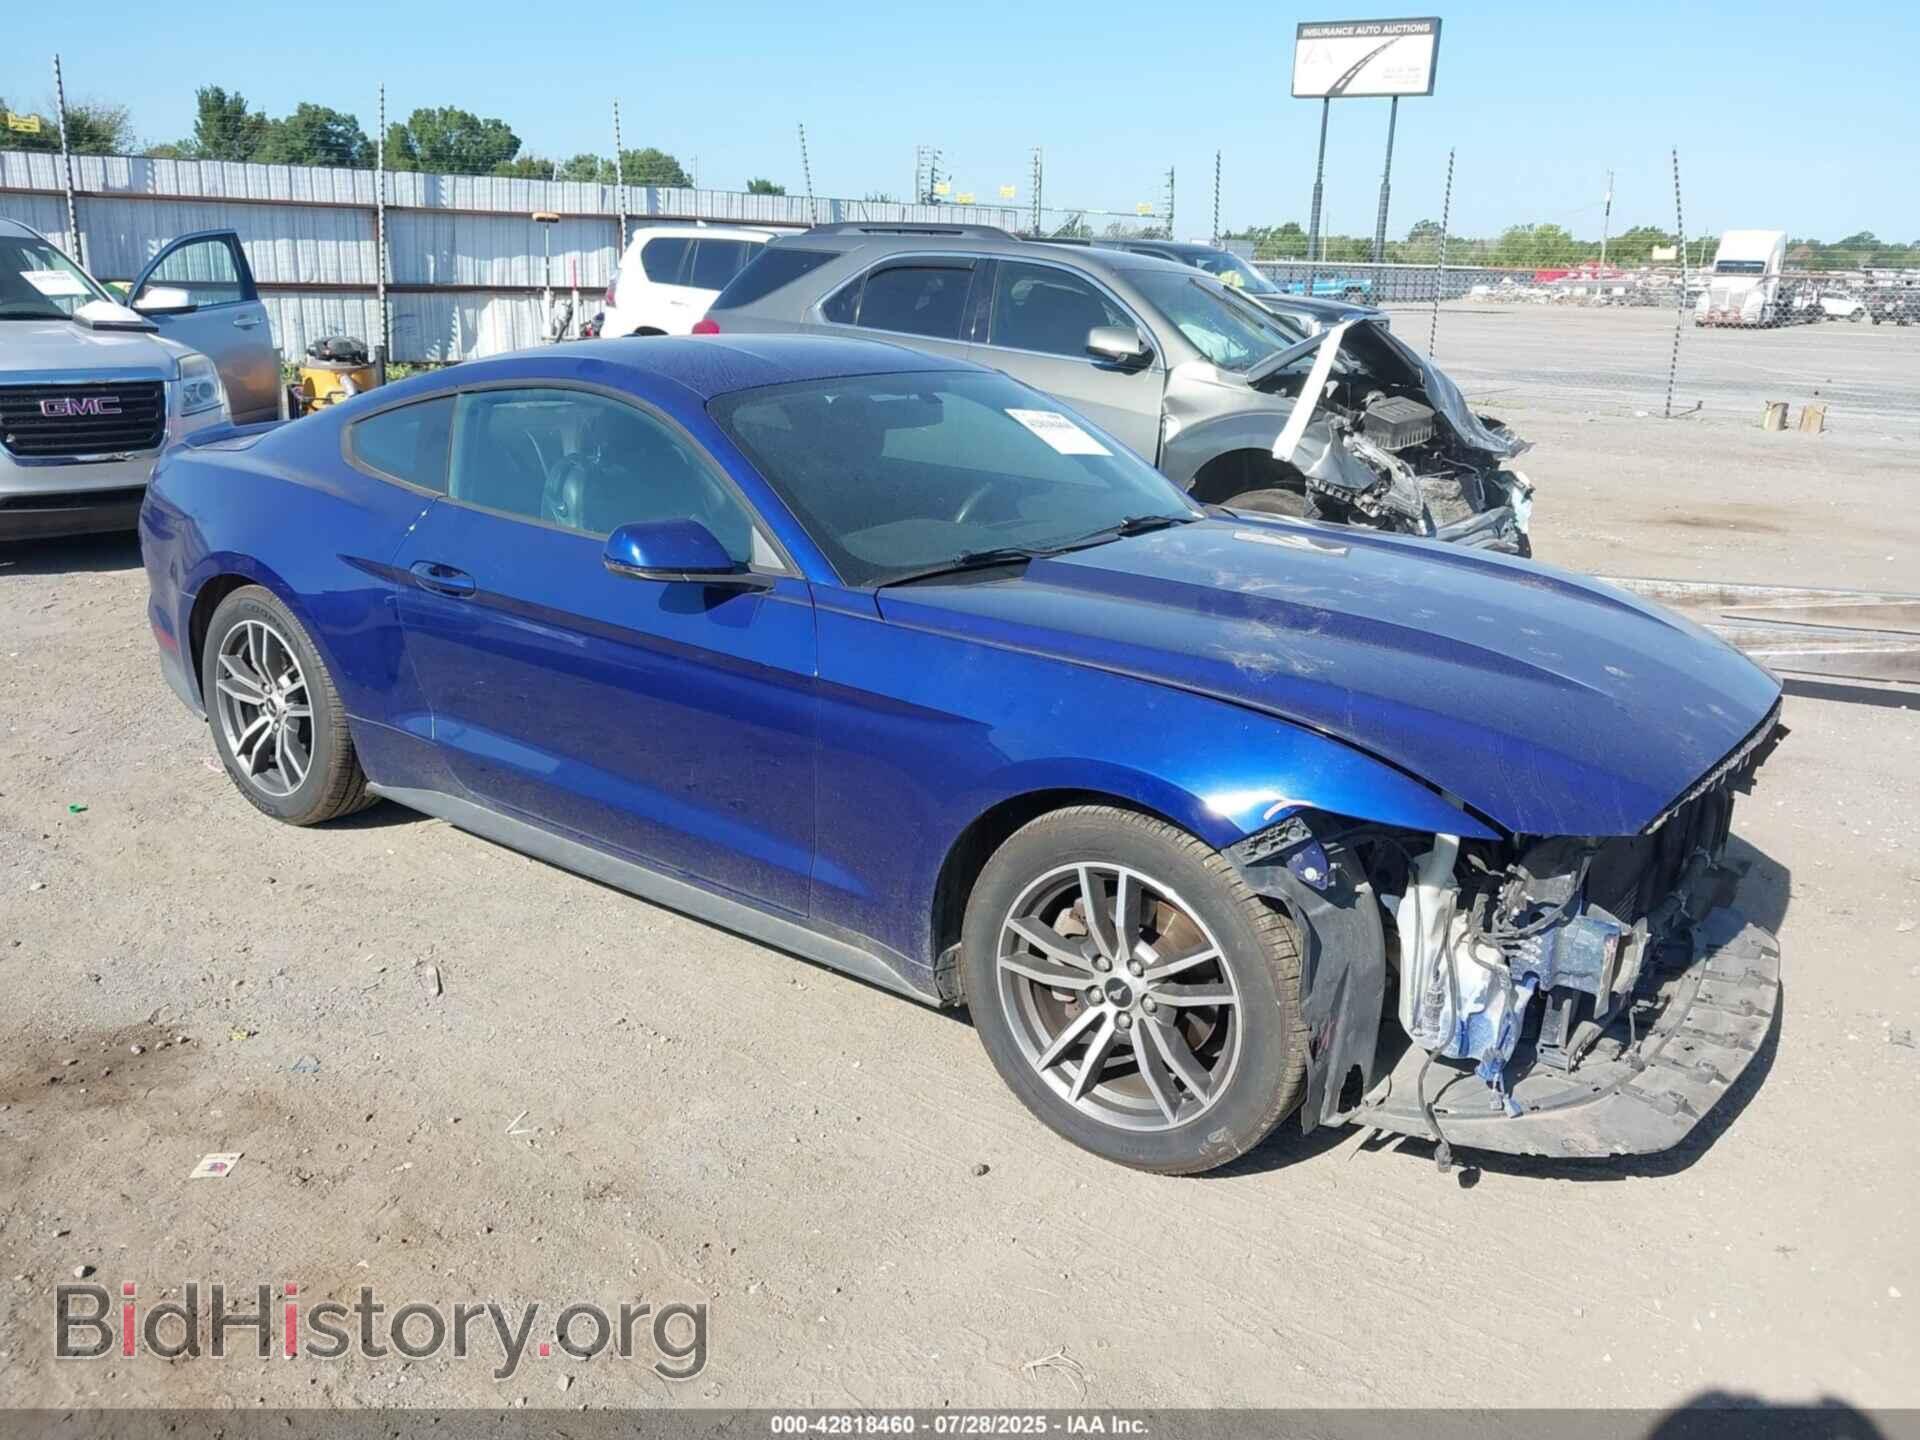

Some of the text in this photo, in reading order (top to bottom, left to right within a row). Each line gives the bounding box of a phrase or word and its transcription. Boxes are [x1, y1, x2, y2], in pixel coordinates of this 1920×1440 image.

[1302, 23, 1431, 37] INSURANCE AUTO AUCTIONS
[41, 397, 122, 416] GMC
